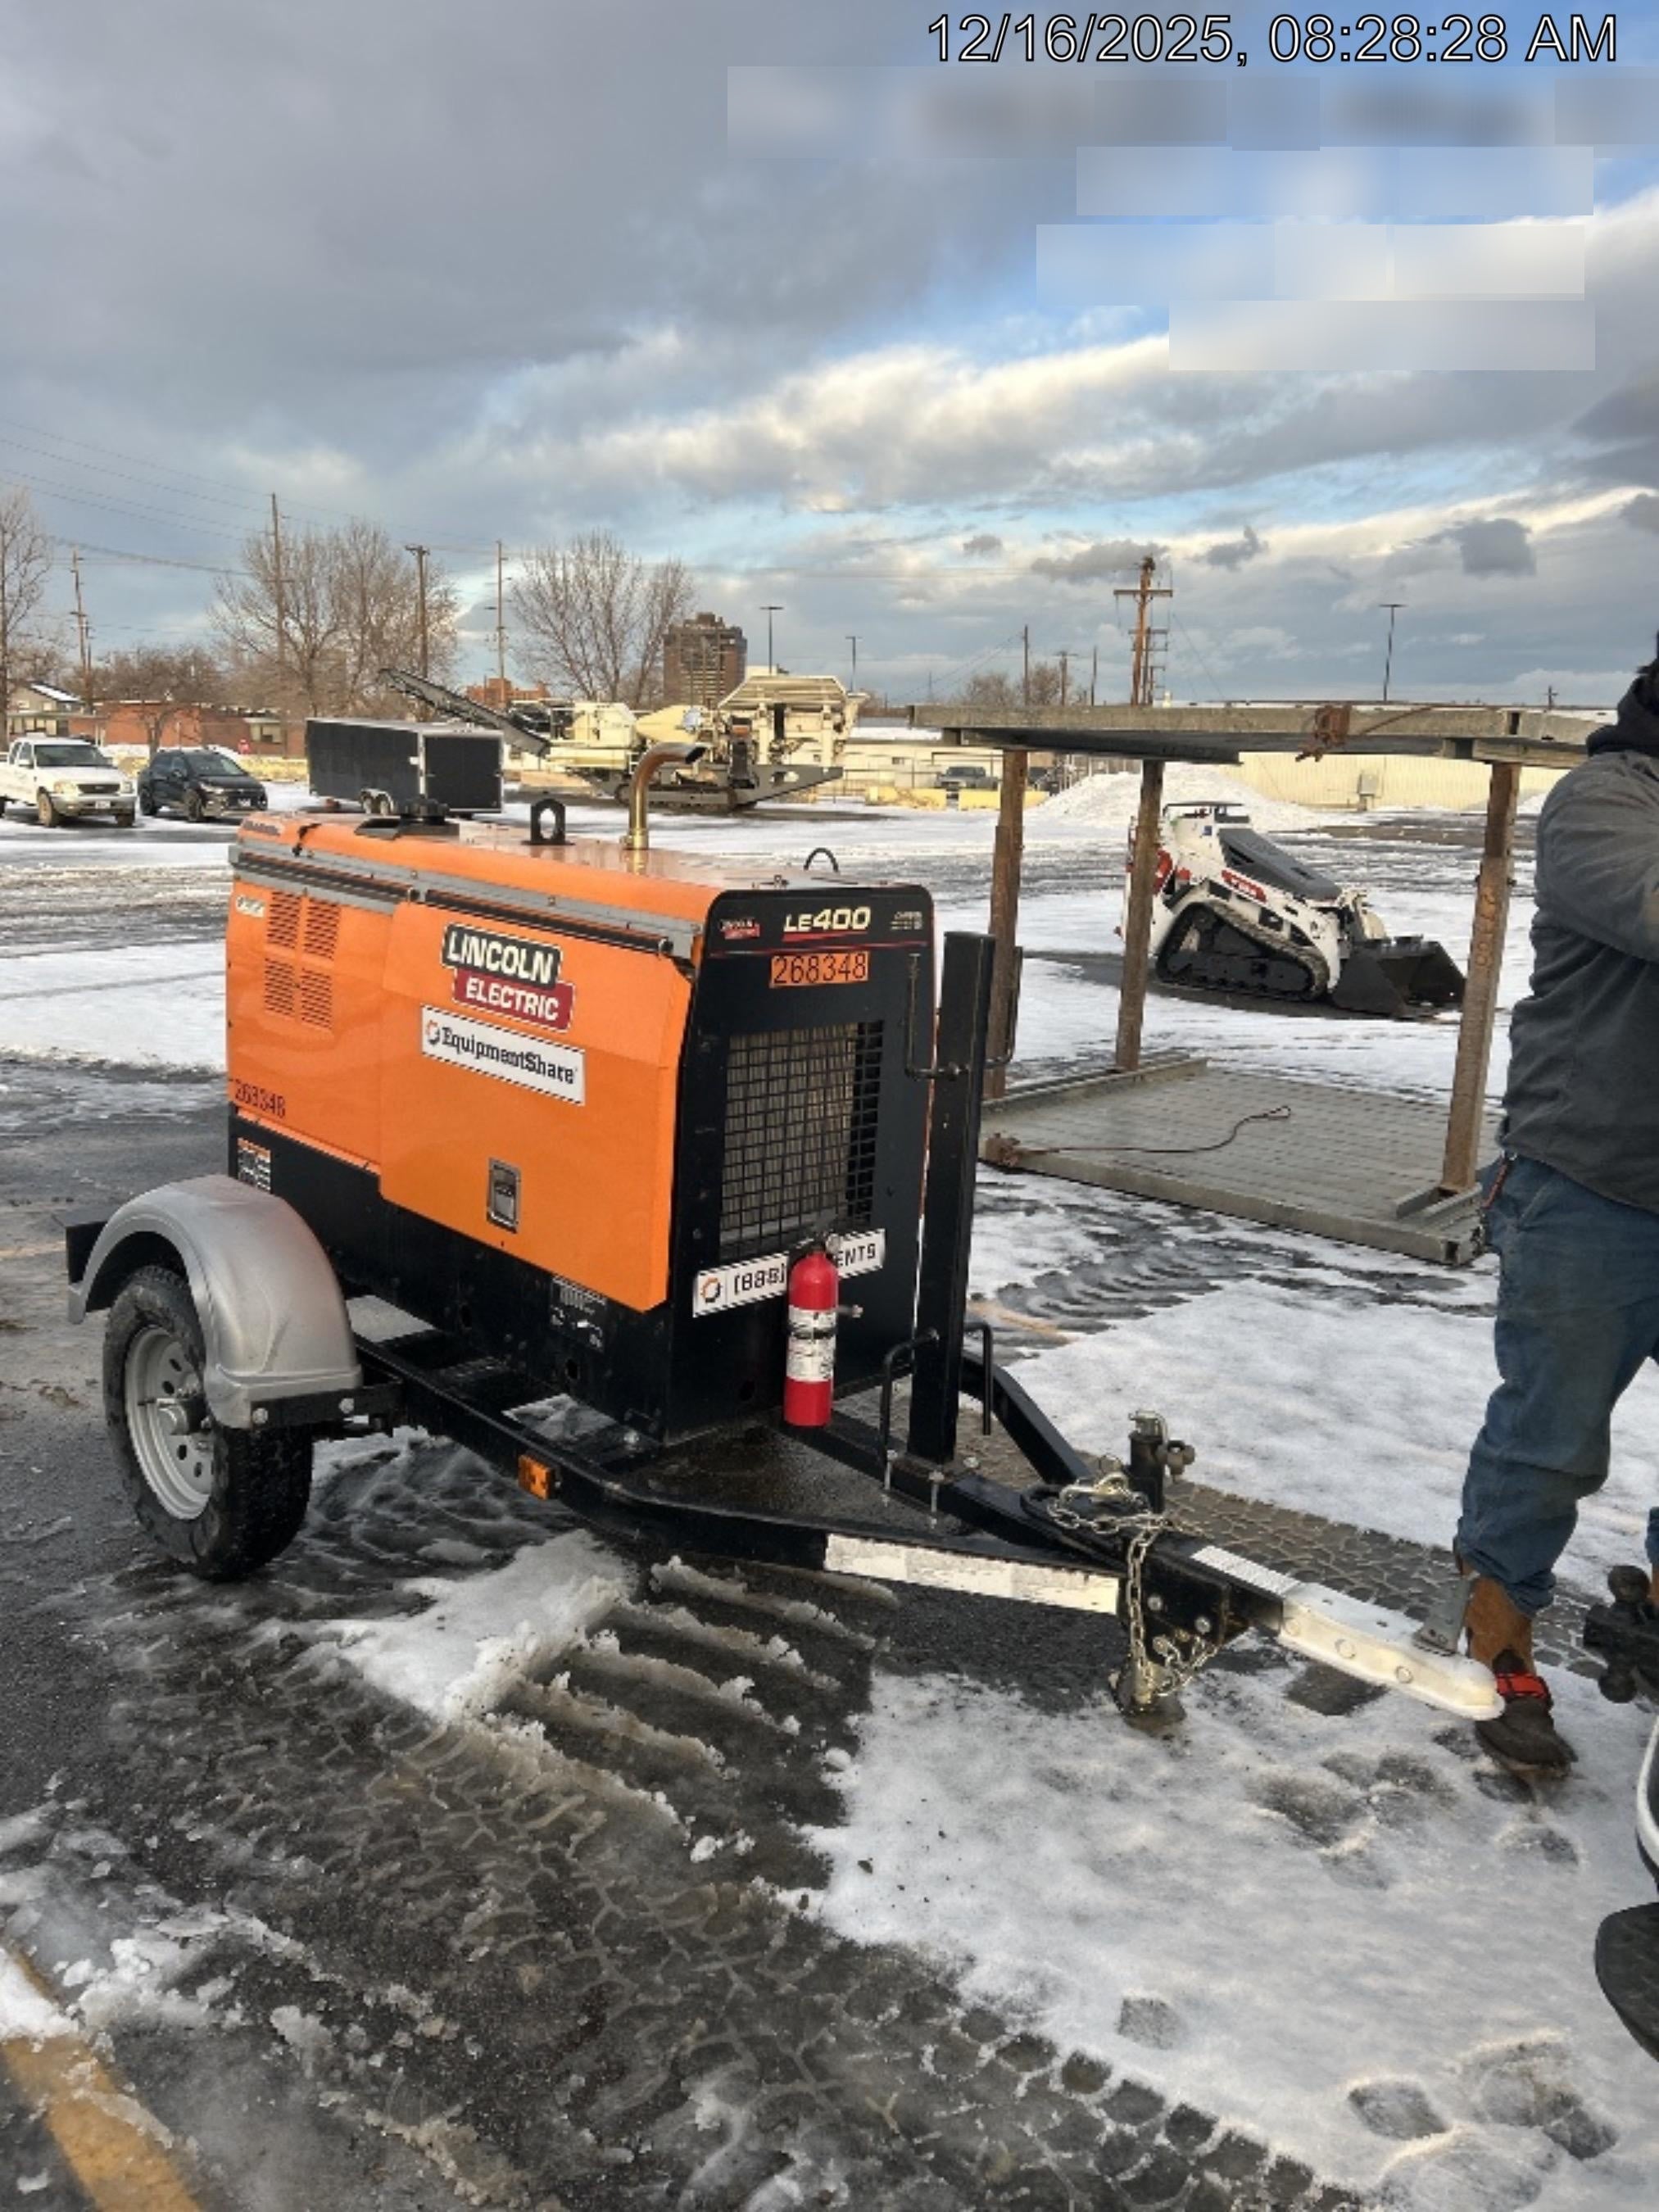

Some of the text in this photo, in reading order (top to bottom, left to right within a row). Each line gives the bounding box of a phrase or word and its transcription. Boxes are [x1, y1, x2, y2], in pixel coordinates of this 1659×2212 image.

[783, 906, 871, 932] LE400
[446, 930, 554, 984] LINCOLN
[773, 952, 866, 983] 268348
[465, 977, 560, 1021] ELECTRIC
[442, 1026, 575, 1085] EquipmentShare
